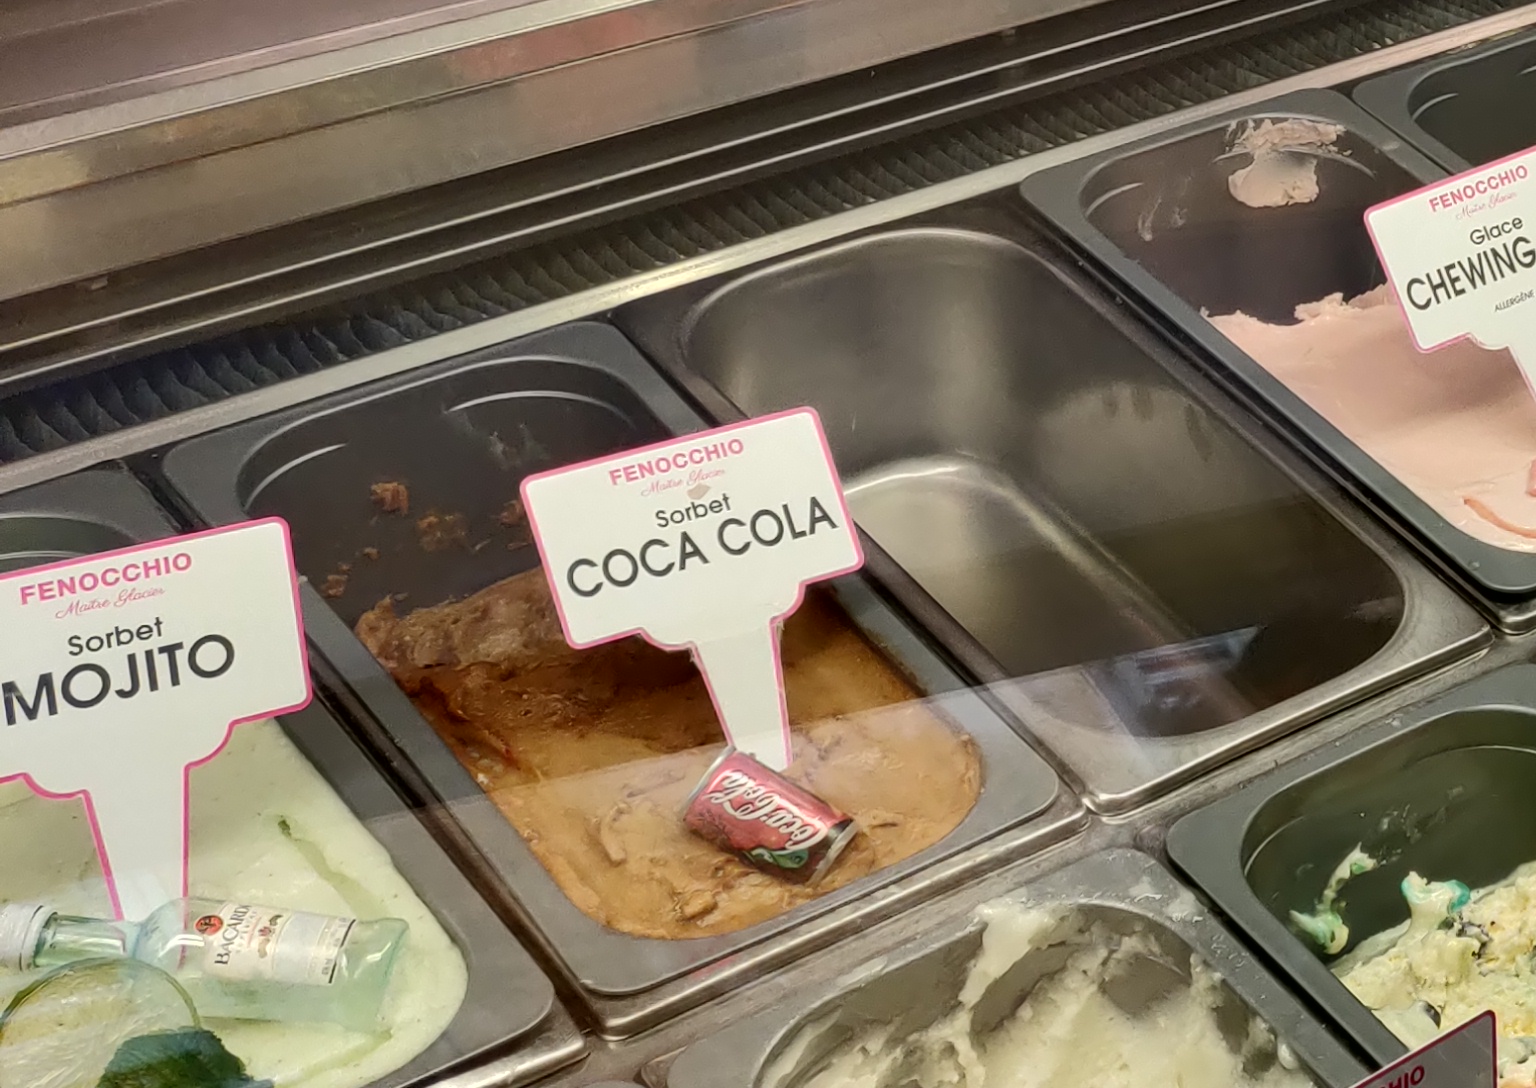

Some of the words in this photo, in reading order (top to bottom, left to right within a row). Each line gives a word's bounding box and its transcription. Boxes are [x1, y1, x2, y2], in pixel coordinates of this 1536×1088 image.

[1429, 165, 1528, 212] FENOCCHIO
[1469, 217, 1523, 245] Glace
[1406, 236, 1536, 311] CHEWING
[609, 438, 744, 485] FENOCCHIO
[655, 493, 732, 528] Sorbet
[567, 530, 710, 597] COCA
[717, 496, 839, 556] COLA
[19, 552, 192, 606] FENOCCHIO
[67, 616, 163, 656] Sorbet
[1, 634, 235, 726] MOJITO
